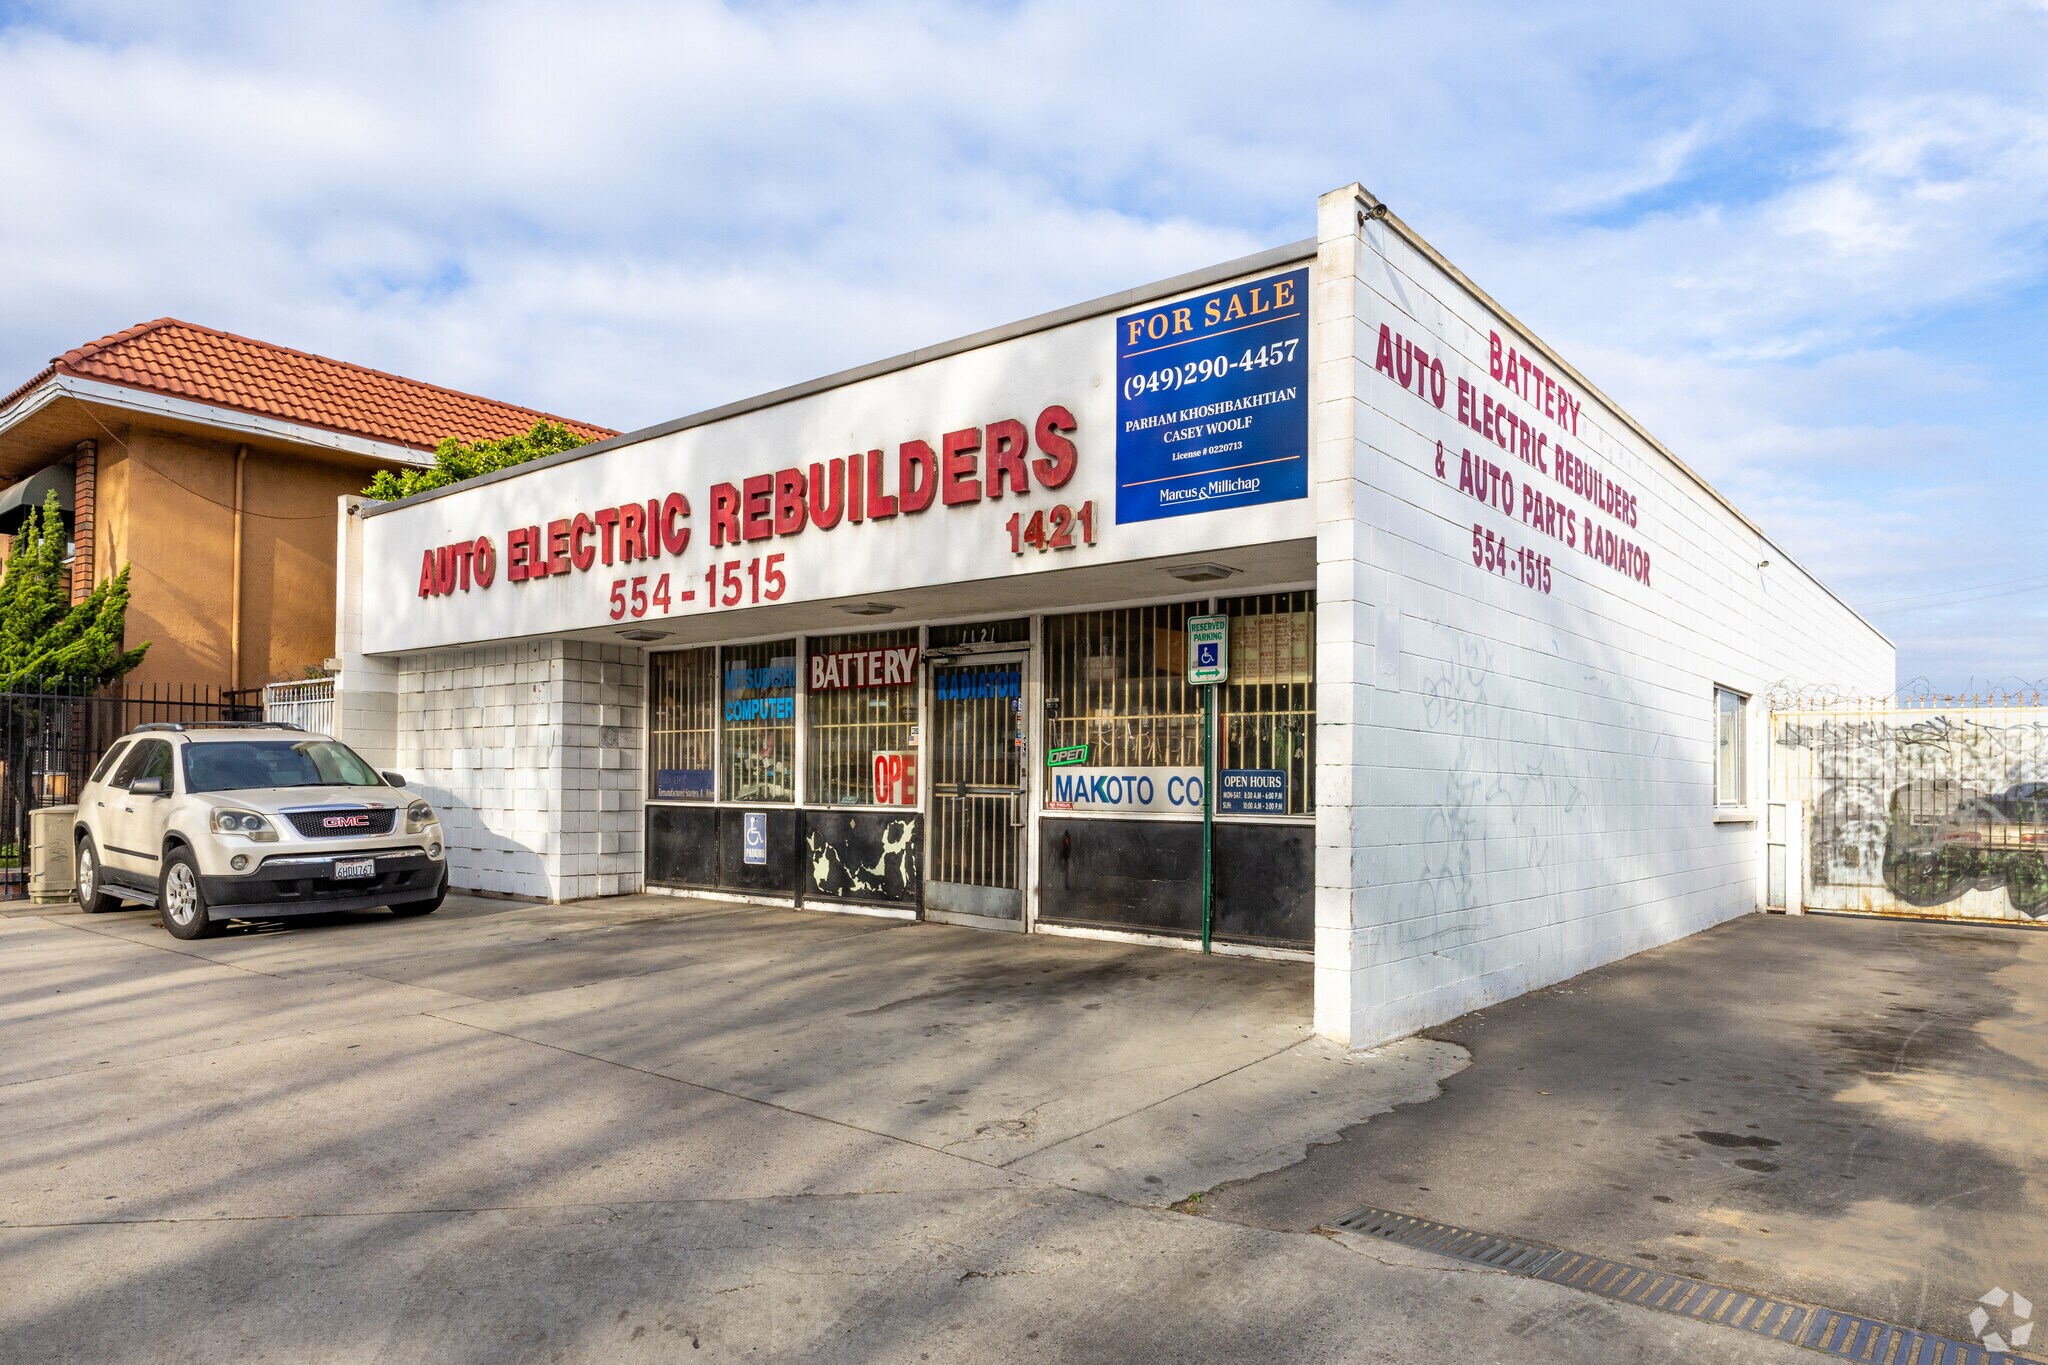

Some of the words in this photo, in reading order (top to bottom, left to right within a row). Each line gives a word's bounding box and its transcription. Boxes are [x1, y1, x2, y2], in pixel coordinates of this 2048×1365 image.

[1127, 308, 1193, 346] FOR
[1204, 279, 1295, 327] SALE
[1123, 338, 1299, 400] (949)290-4457
[1489, 329, 1582, 437] BATTERY
[1125, 412, 1177, 432] PARHAM
[1179, 387, 1296, 423] KHOSHBAKHTIAN
[1163, 426, 1203, 444] CASEY
[1206, 416, 1253, 436] WOOLF
[1375, 322, 1446, 410] AUTO
[1457, 376, 1548, 475] ELECTRIC
[1555, 443, 1637, 529] REBUILDERS
[1172, 450, 1201, 461] License
[1208, 441, 1243, 454] 0220713
[418, 535, 496, 599] AUTO
[508, 491, 691, 582] ELECTRIC
[709, 404, 1079, 547] REBUILDERS
[1160, 488, 1198, 502] Marcus
[1208, 478, 1260, 495] Millichap
[1005, 500, 1098, 556] 1421
[1435, 439, 1446, 480] &
[1459, 448, 1514, 517] AUTO
[1523, 482, 1576, 549] PARTS
[1584, 516, 1651, 587] RADIATOR
[1191, 622, 1225, 632] RESERVED
[1193, 632, 1222, 641] PARKING
[812, 647, 918, 689] BATTERY
[937, 671, 1021, 700] RADIATOR
[725, 697, 794, 721] COMPUTER
[1051, 748, 1085, 763] OPEN
[874, 754, 918, 805] OPE
[1055, 775, 1154, 805] MAKOTO
[1167, 775, 1204, 806] CO
[1224, 776, 1248, 788] OPEN
[1249, 776, 1282, 788] HOURS
[323, 815, 369, 828] GMC
